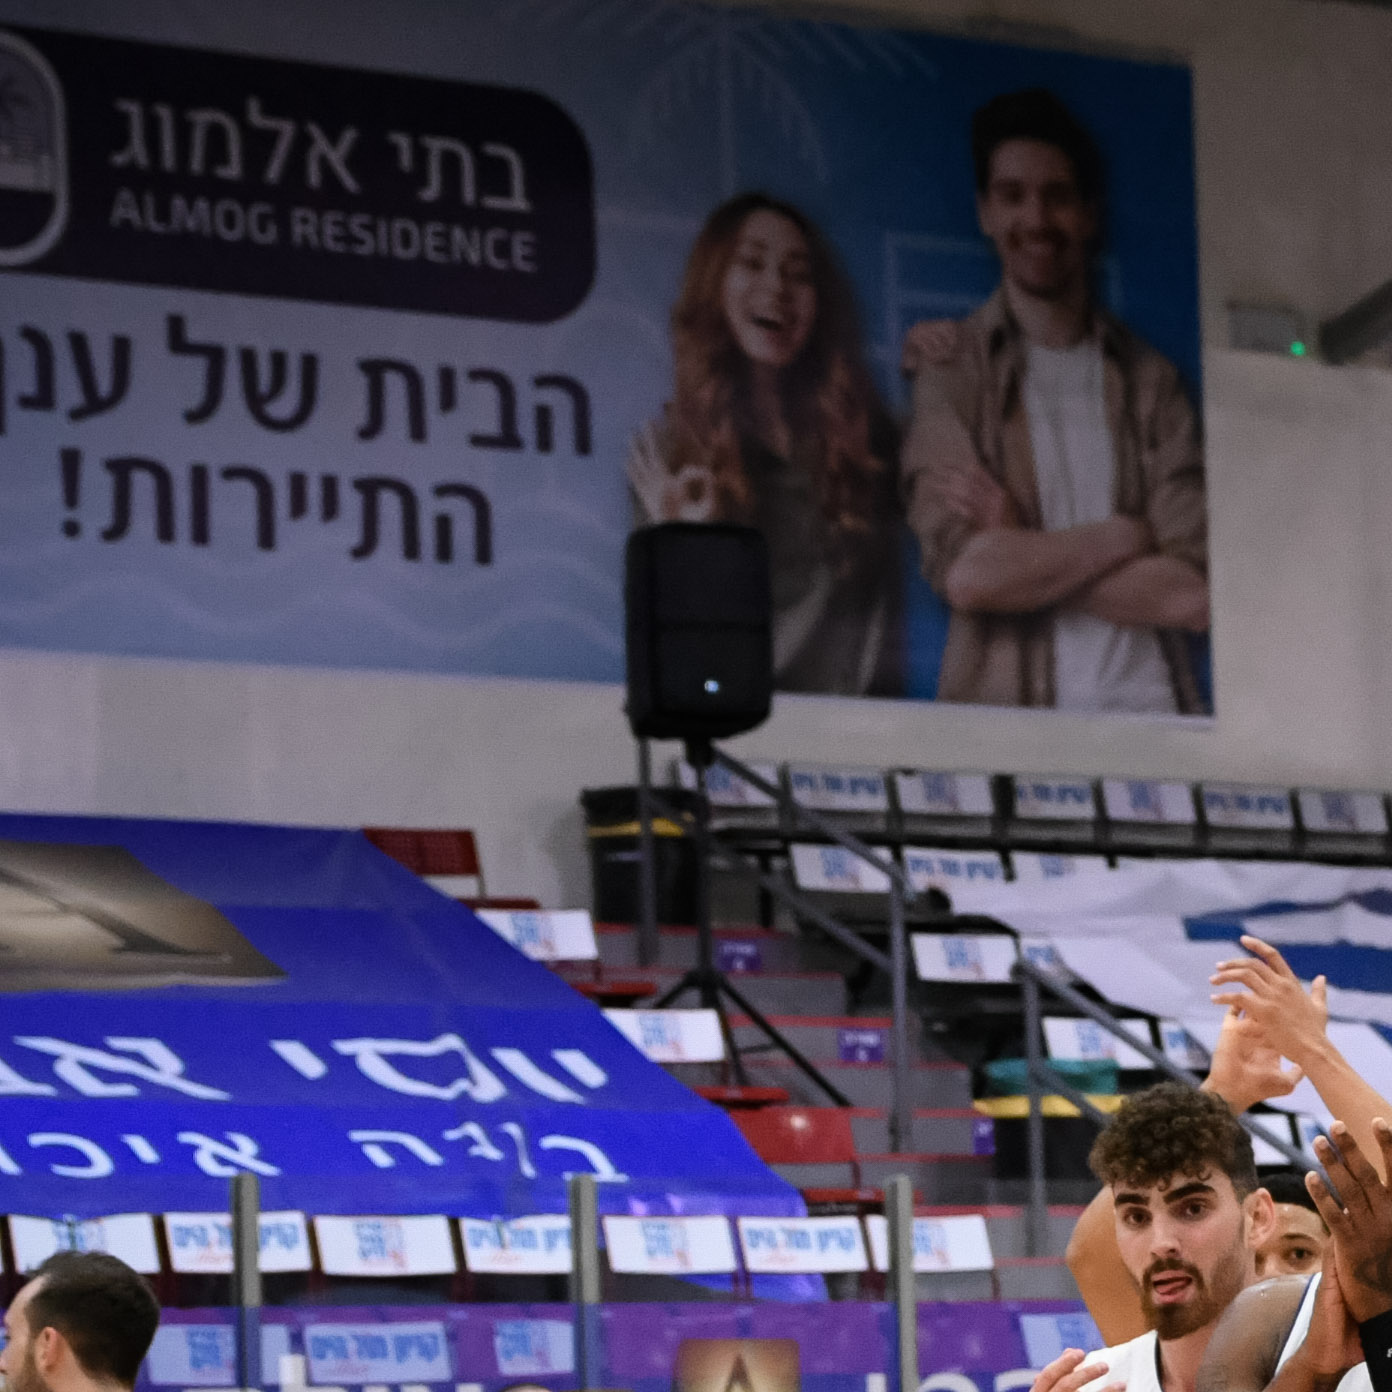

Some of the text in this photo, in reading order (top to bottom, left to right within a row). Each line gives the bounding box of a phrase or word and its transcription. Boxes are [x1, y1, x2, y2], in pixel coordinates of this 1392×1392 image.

[111, 98, 532, 212] בתי אלמוג
[109, 188, 538, 273] ALMOG RESIDENCE
[0, 313, 594, 456] הבית של ענ
[58, 447, 494, 566] התיירות!
